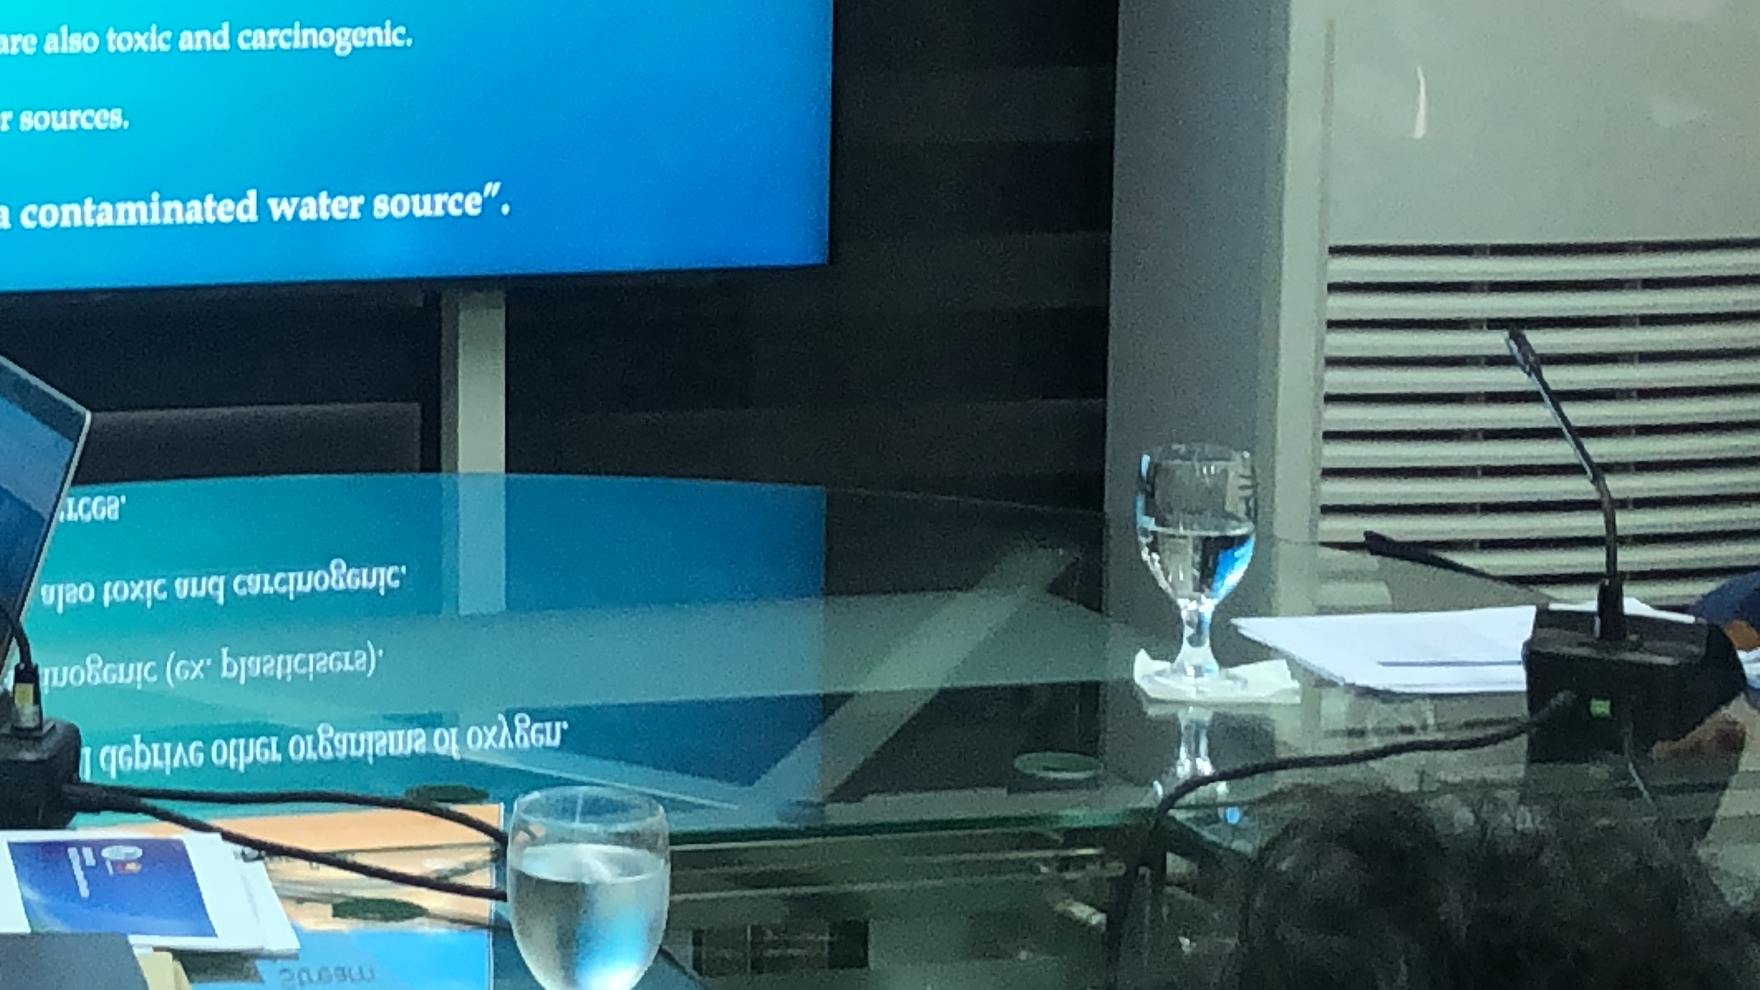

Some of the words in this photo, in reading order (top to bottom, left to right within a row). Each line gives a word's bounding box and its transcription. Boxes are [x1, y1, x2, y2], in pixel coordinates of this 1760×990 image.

[42, 24, 100, 55] also
[105, 23, 173, 54] toxic
[177, 20, 231, 52] and
[236, 19, 413, 58] carcinogenic.
[18, 107, 130, 132] sources.
[19, 188, 260, 230] contaminated
[266, 190, 366, 223] water
